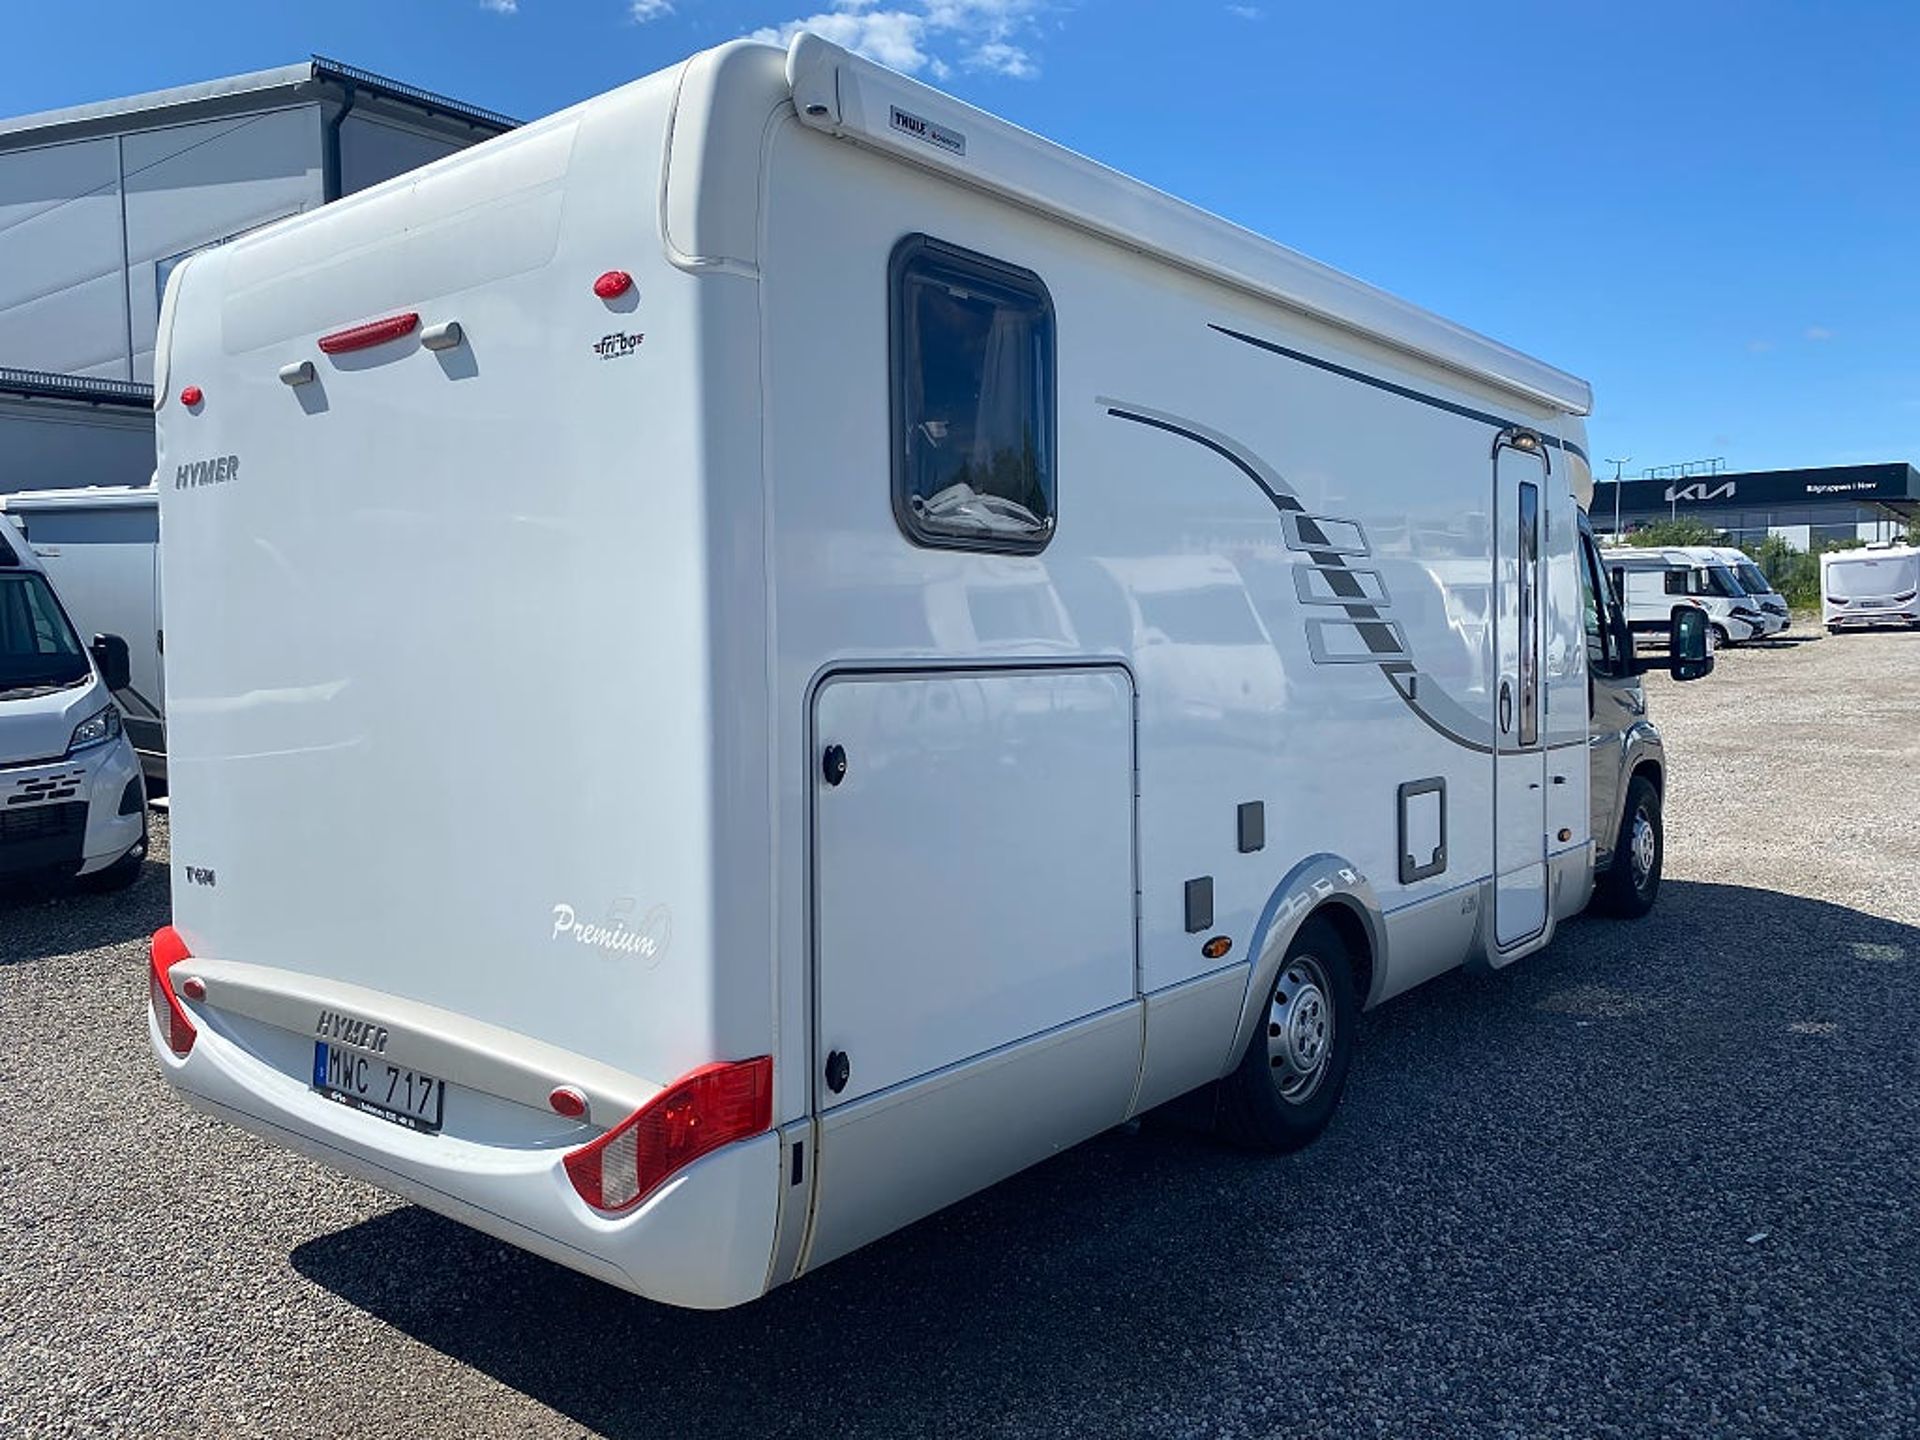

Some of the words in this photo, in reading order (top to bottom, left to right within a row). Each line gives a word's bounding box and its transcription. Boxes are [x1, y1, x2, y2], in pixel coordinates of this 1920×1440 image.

[895, 111, 927, 136] THULE
[176, 455, 239, 490] HYMER
[551, 903, 657, 957] Premium
[316, 1010, 389, 1053] HYMER
[328, 1047, 369, 1094] MWC
[386, 1066, 433, 1115] 717
